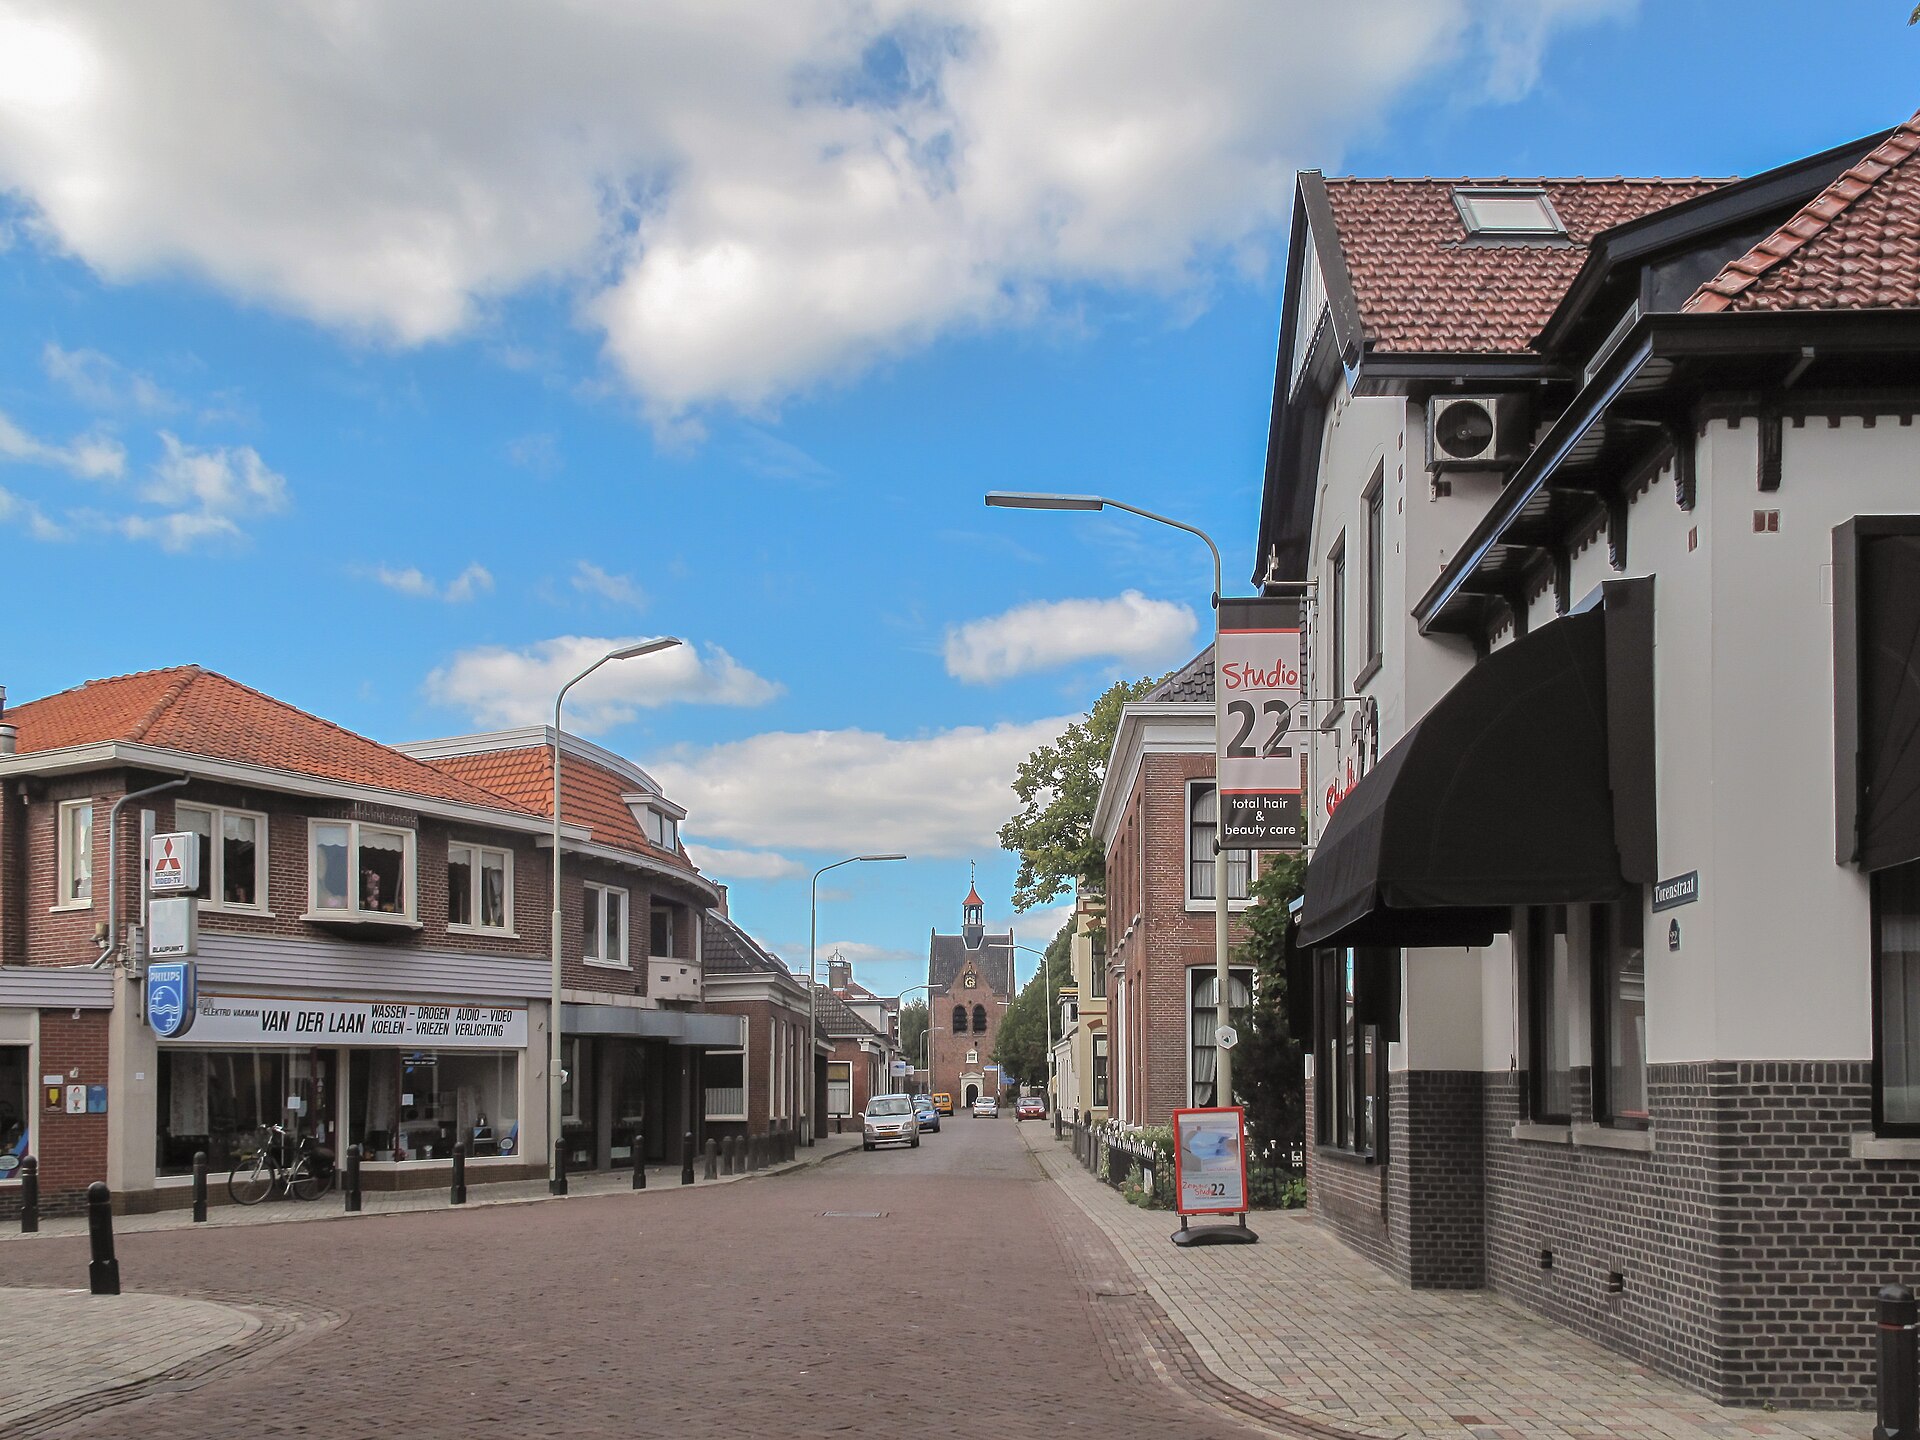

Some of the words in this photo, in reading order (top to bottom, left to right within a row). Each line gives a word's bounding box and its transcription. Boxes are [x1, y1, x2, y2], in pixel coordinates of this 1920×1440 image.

[1222, 658, 1298, 689] Studio
[1227, 700, 1292, 758] 22
[1232, 796, 1260, 809] total
[1264, 796, 1288, 809] hair
[1255, 810, 1265, 822] &
[1225, 823, 1266, 838] beauty
[1269, 826, 1296, 835] care
[1654, 877, 1694, 903] Torenstraat
[152, 945, 184, 953] BLAUPUNKT
[150, 971, 180, 981] PHILIPS
[203, 1008, 231, 1017] ELEKTRO
[233, 1009, 259, 1018] VAKMAN
[262, 1010, 290, 1032] VAN
[296, 1011, 324, 1033] DER
[329, 1012, 366, 1034] LAAN
[371, 1005, 407, 1019] WASSEN
[418, 1006, 450, 1021] DROGEN
[456, 1008, 480, 1021] AUDIO
[490, 1010, 512, 1022] VIDEO
[371, 1021, 404, 1034] KOELEN
[416, 1022, 449, 1035] VRIEZEN
[455, 1023, 504, 1037] VERLICHTING
[1211, 1183, 1226, 1196] 22
